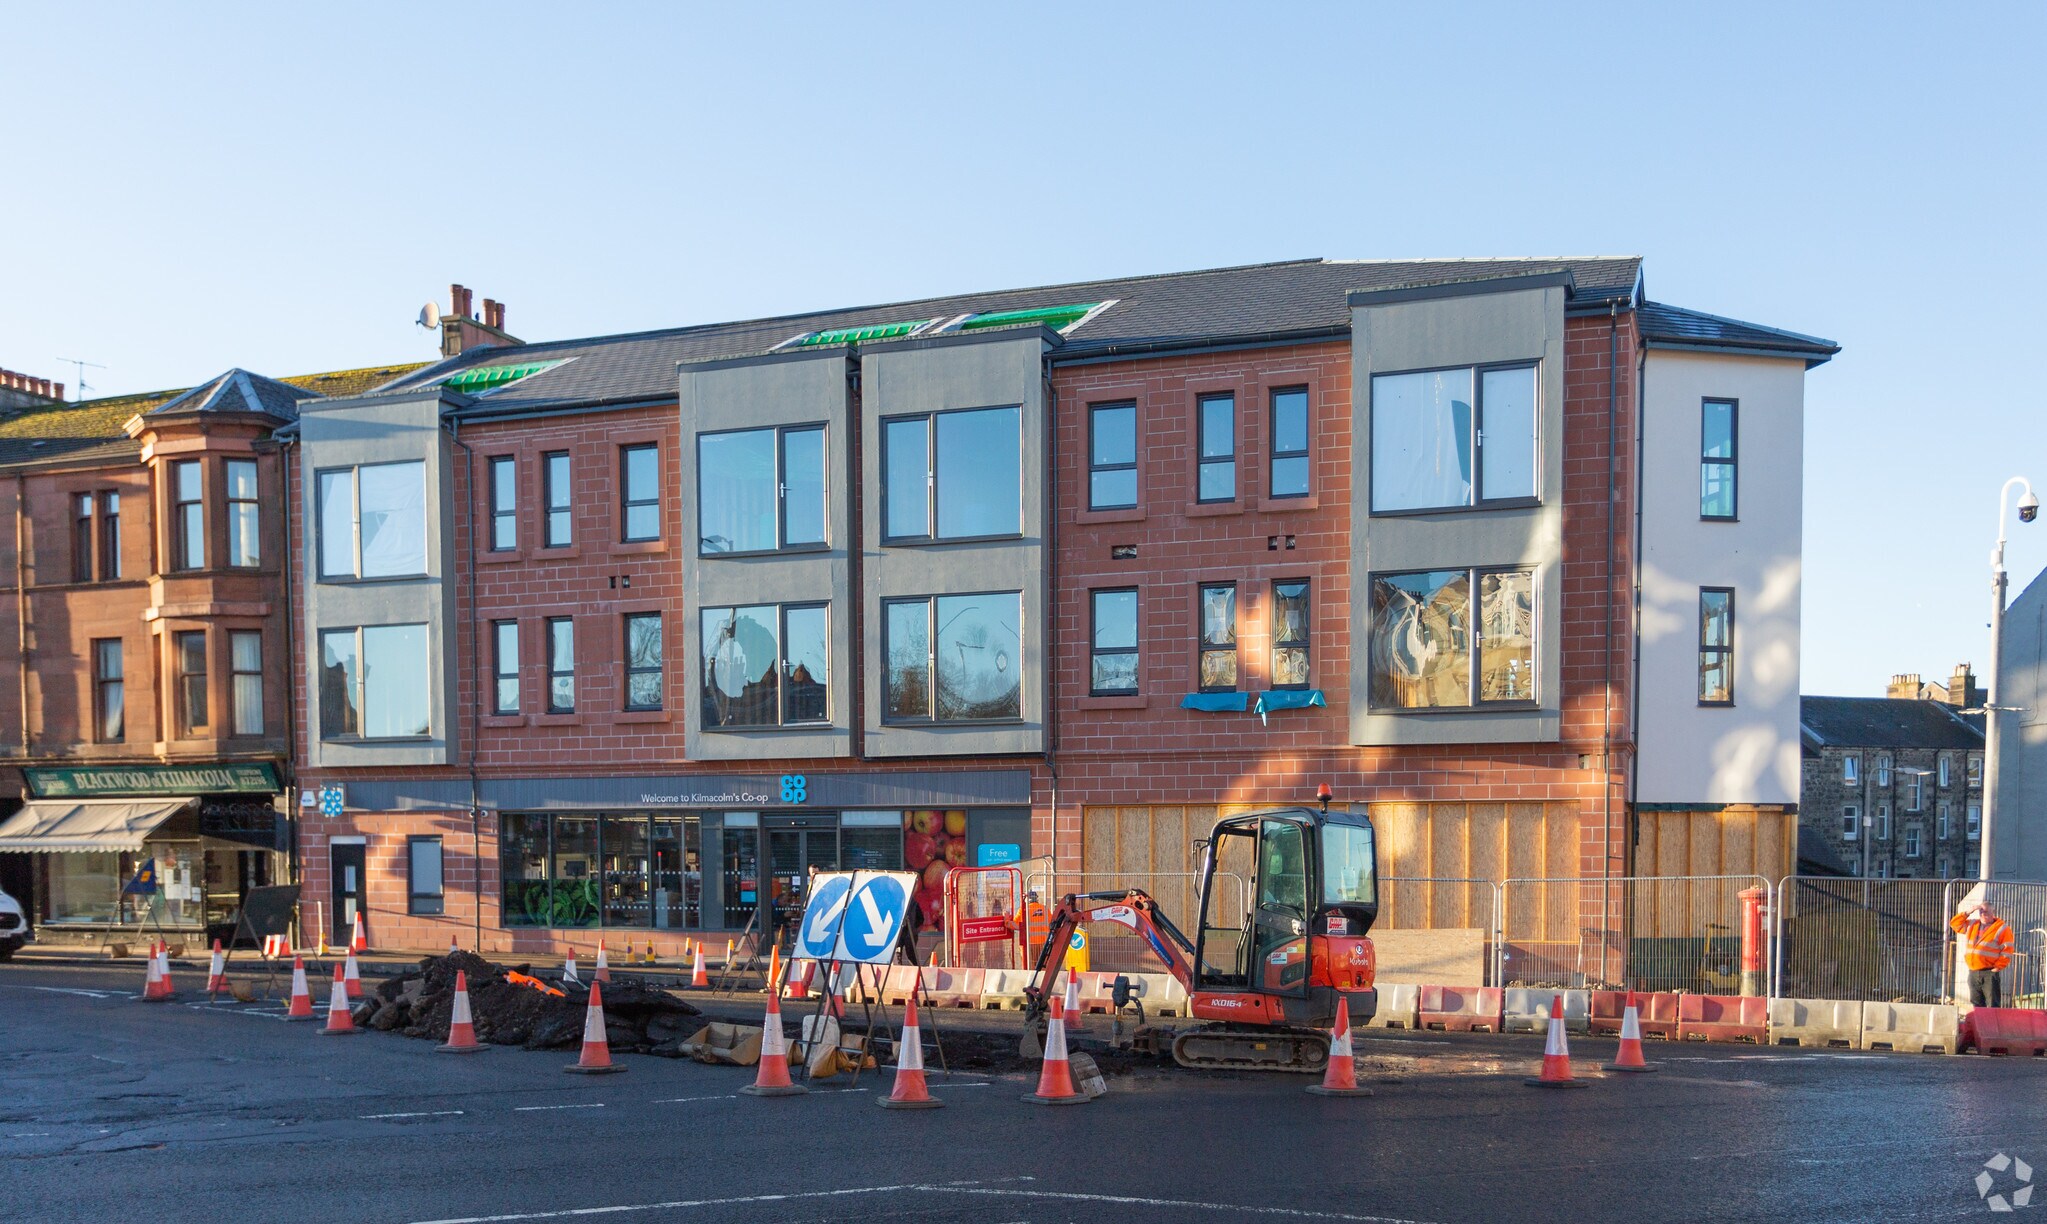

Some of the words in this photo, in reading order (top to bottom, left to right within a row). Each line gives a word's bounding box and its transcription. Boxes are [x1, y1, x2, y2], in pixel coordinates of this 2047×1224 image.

[73, 772, 151, 789] BLACKWOOD
[160, 769, 236, 787] KILMACOLM
[641, 794, 679, 803] Welcome
[681, 794, 690, 802] to
[691, 793, 740, 802] Kilmacolm's
[741, 792, 769, 804] Co-op
[989, 848, 1008, 858] Free
[979, 926, 1005, 934] Entrance
[1349, 957, 1369, 966] Kubota
